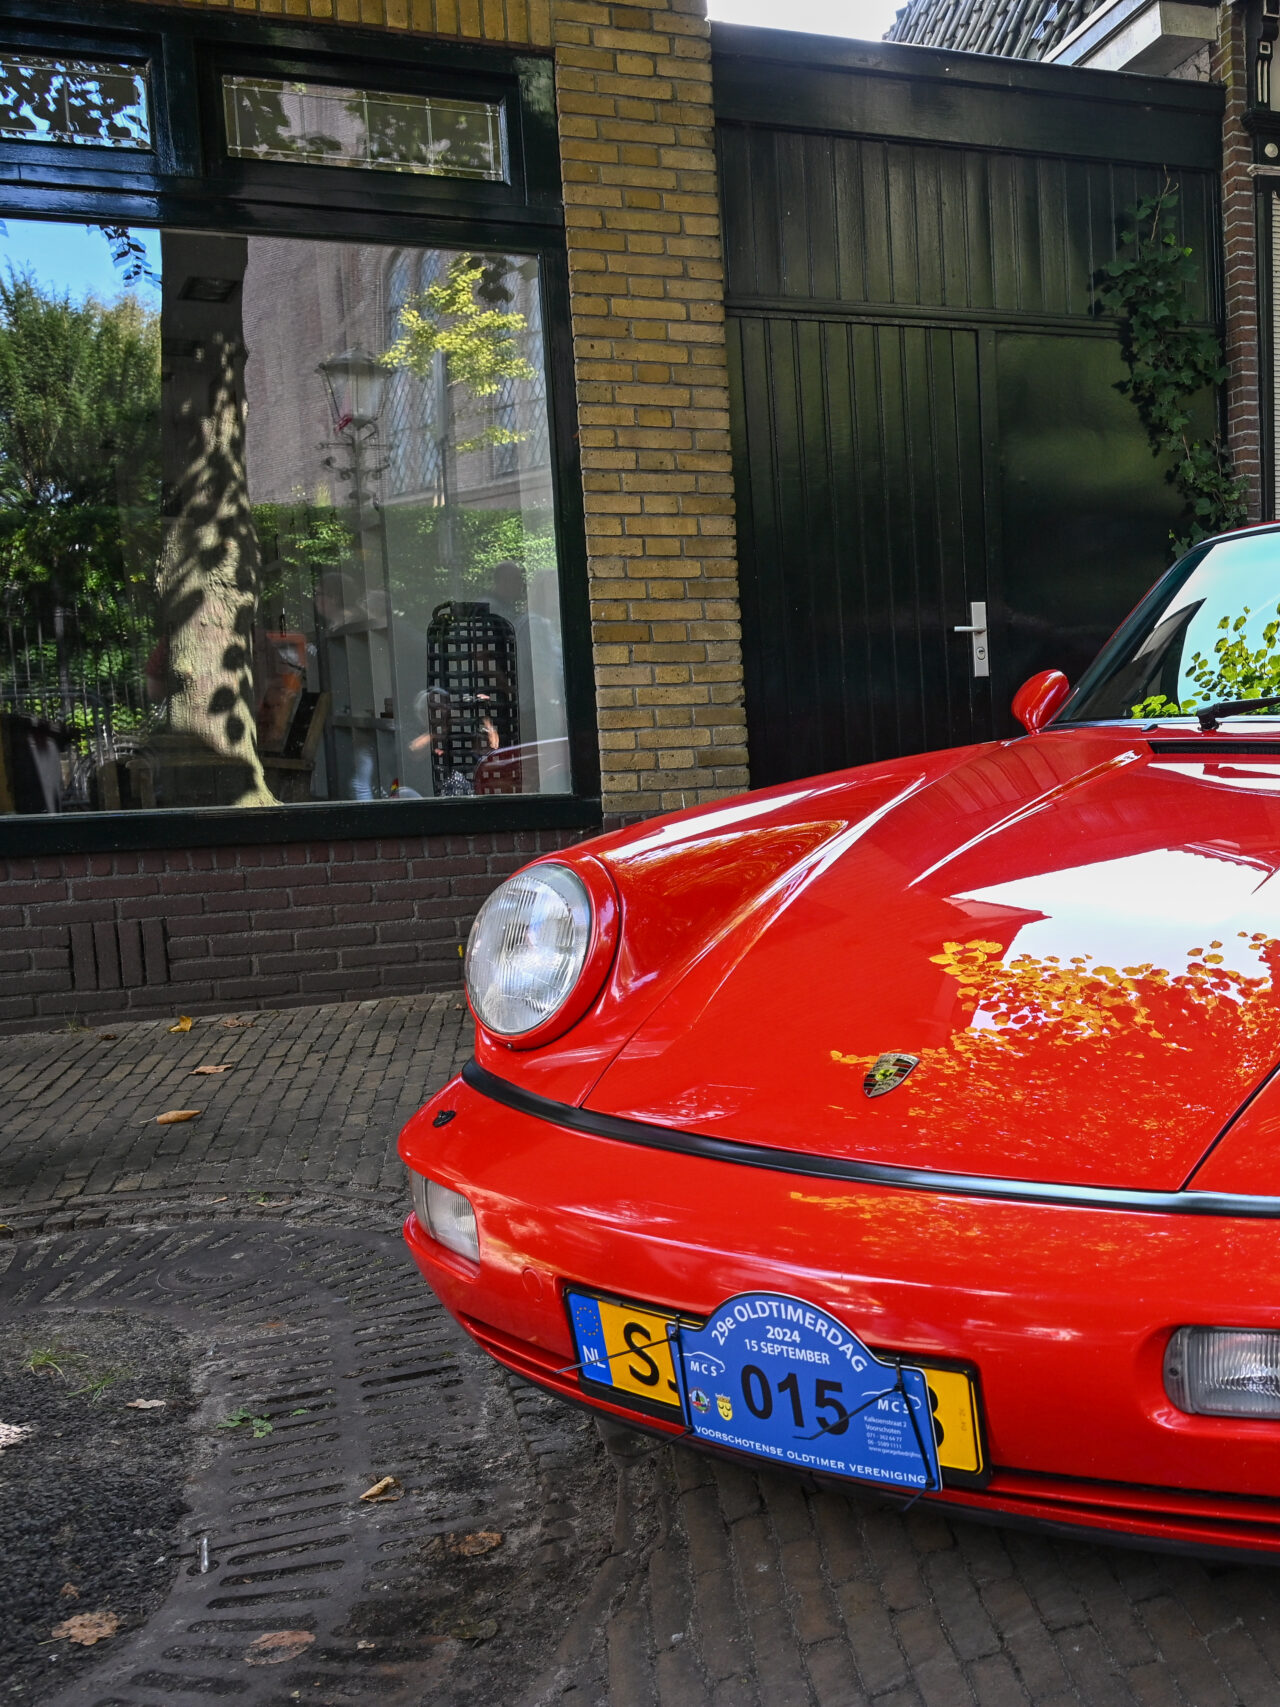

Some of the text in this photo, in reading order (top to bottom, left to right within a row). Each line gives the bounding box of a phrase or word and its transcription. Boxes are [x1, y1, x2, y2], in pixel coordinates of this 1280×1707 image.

[711, 1301, 868, 1373] 29e OLDTIMERDAG
[765, 1325, 801, 1344] 2024
[582, 1344, 606, 1369] NL
[744, 1338, 830, 1366] 15 SEPTEMBER
[741, 1364, 850, 1435] 015
[865, 1424, 902, 1435] Voorschoten
[694, 1424, 927, 1485] VOORSCHOTENSE OLDTIMER VERENIGING
